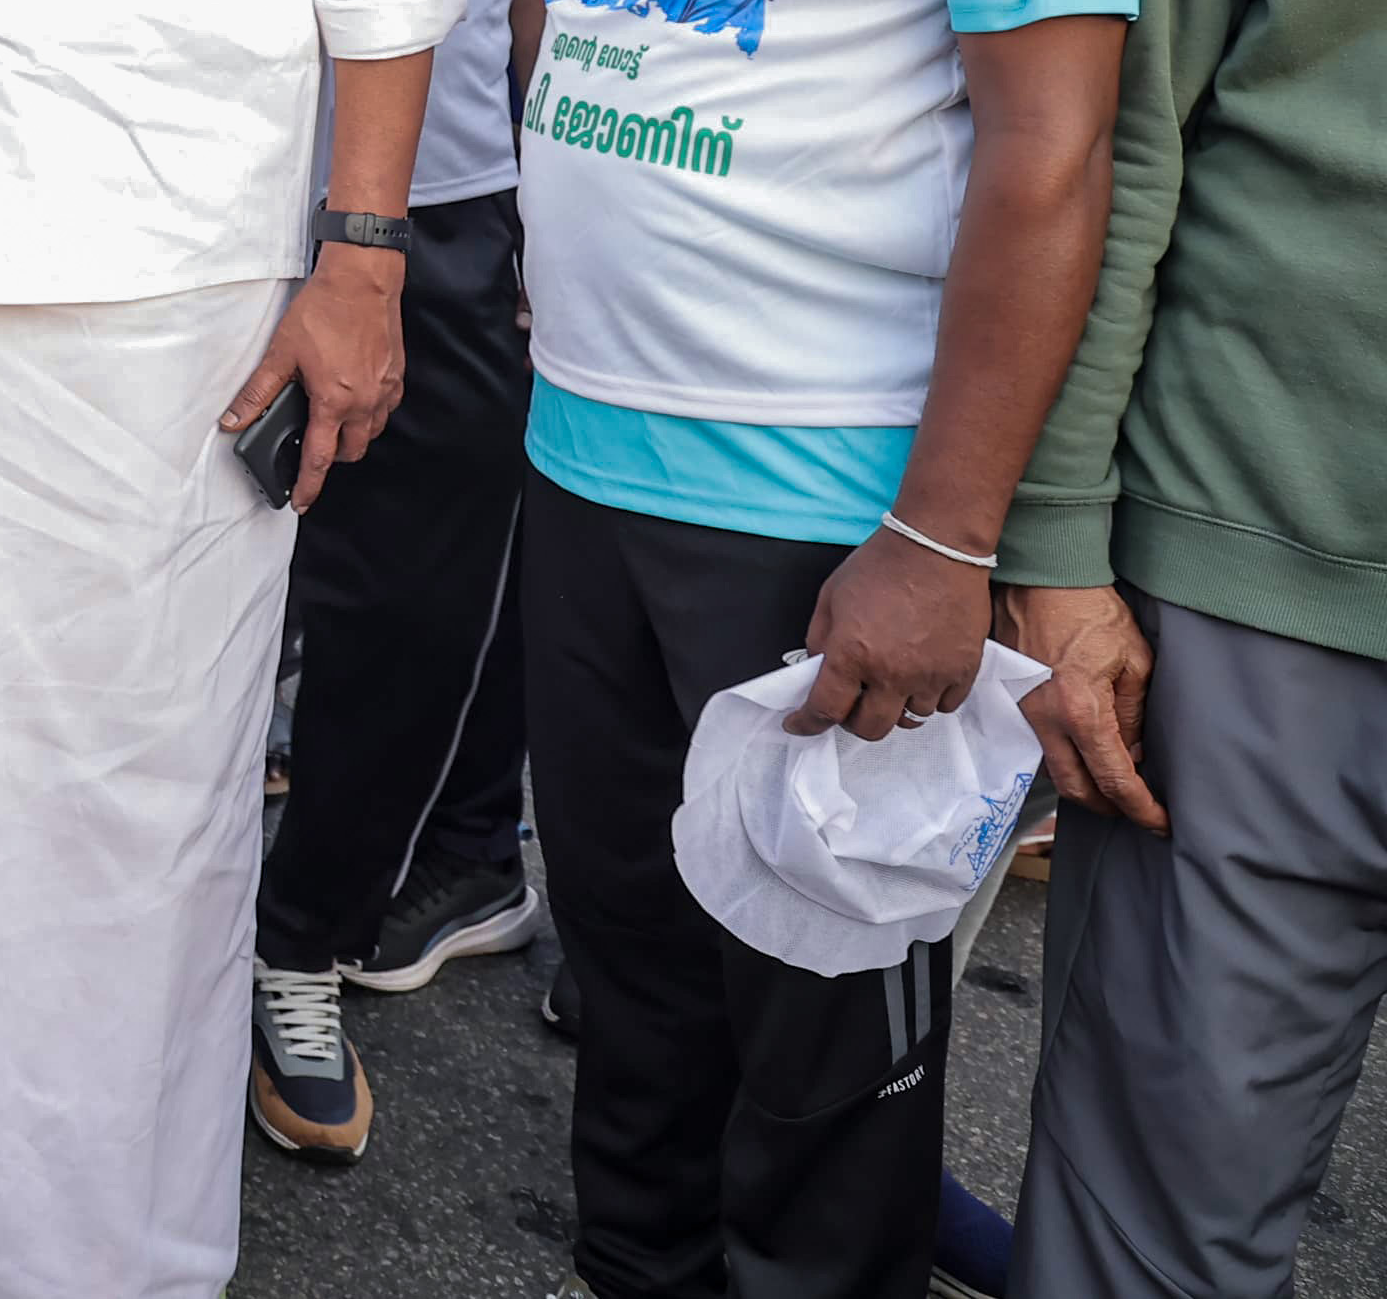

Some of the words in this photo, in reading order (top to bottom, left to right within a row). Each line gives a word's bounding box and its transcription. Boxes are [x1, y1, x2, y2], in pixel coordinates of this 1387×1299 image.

[597, 43, 650, 80] വോട്ട്
[551, 95, 744, 177] ജോണിന്
[886, 1064, 925, 1096] FASTORY
